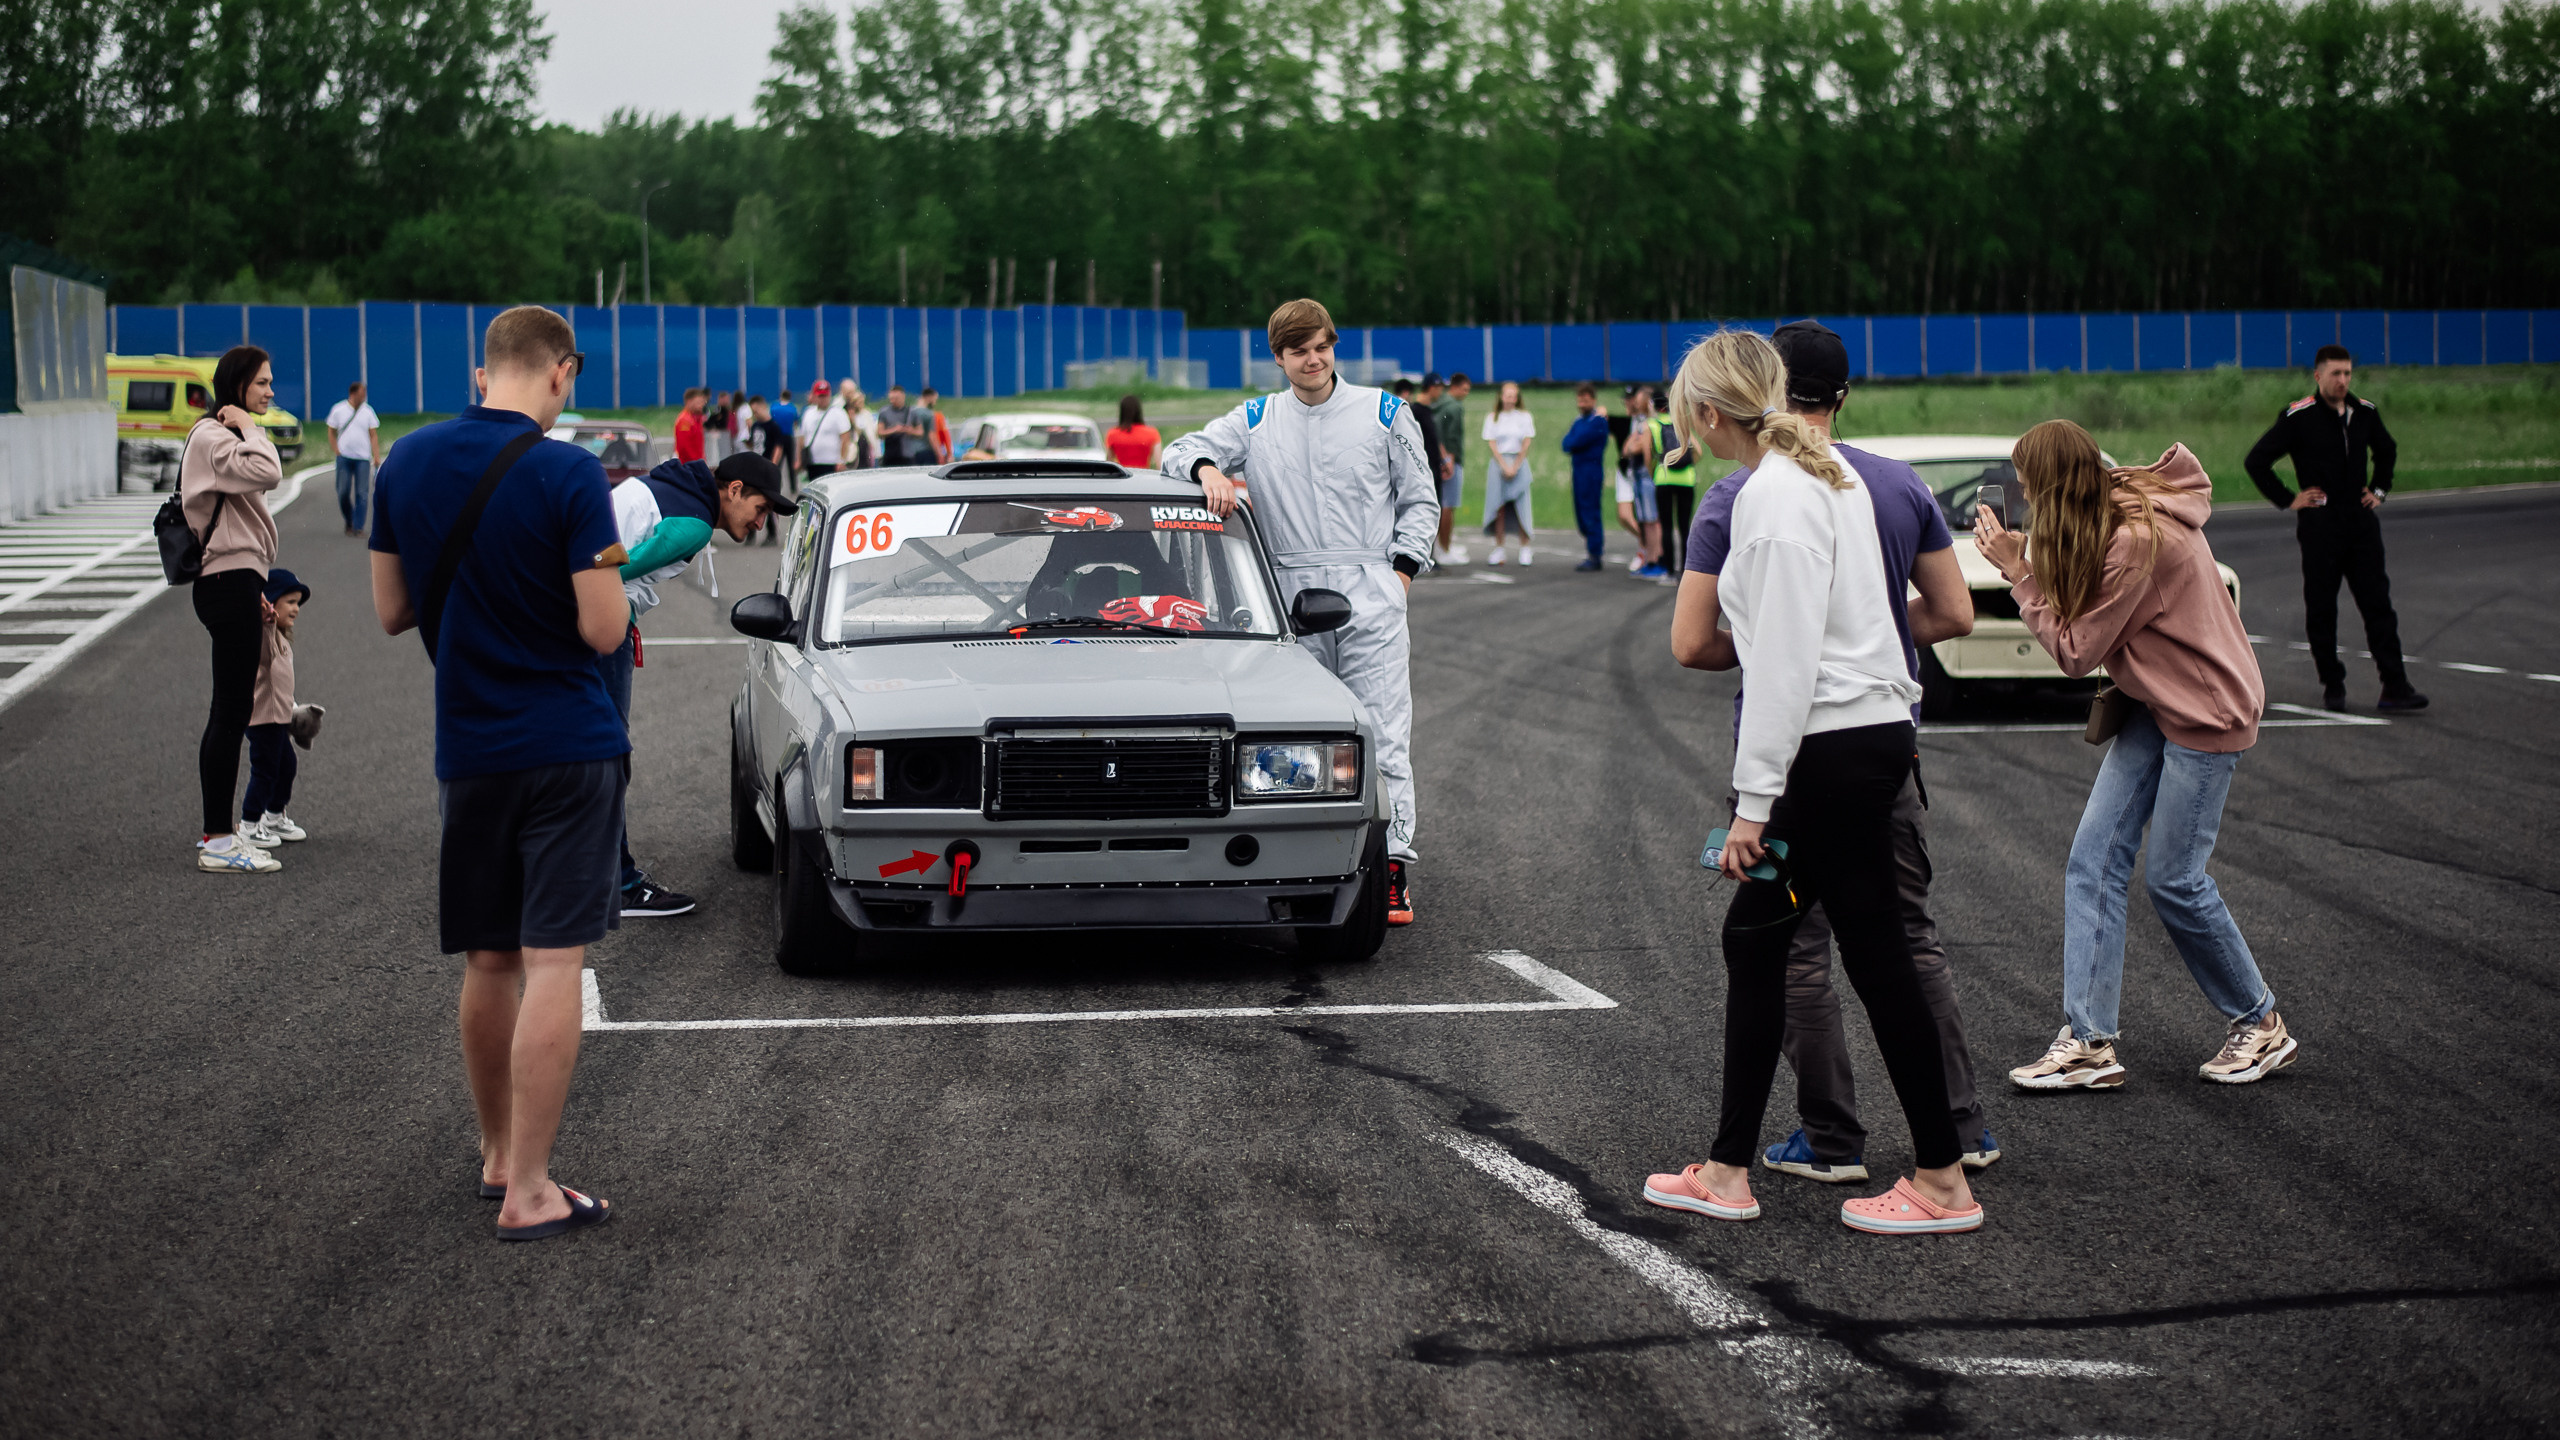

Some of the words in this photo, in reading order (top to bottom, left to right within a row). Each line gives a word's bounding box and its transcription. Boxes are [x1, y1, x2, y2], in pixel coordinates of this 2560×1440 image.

[1151, 506, 1223, 523] КУБОК
[846, 512, 893, 554] 66
[1153, 520, 1224, 532] КЛАССИКИ
